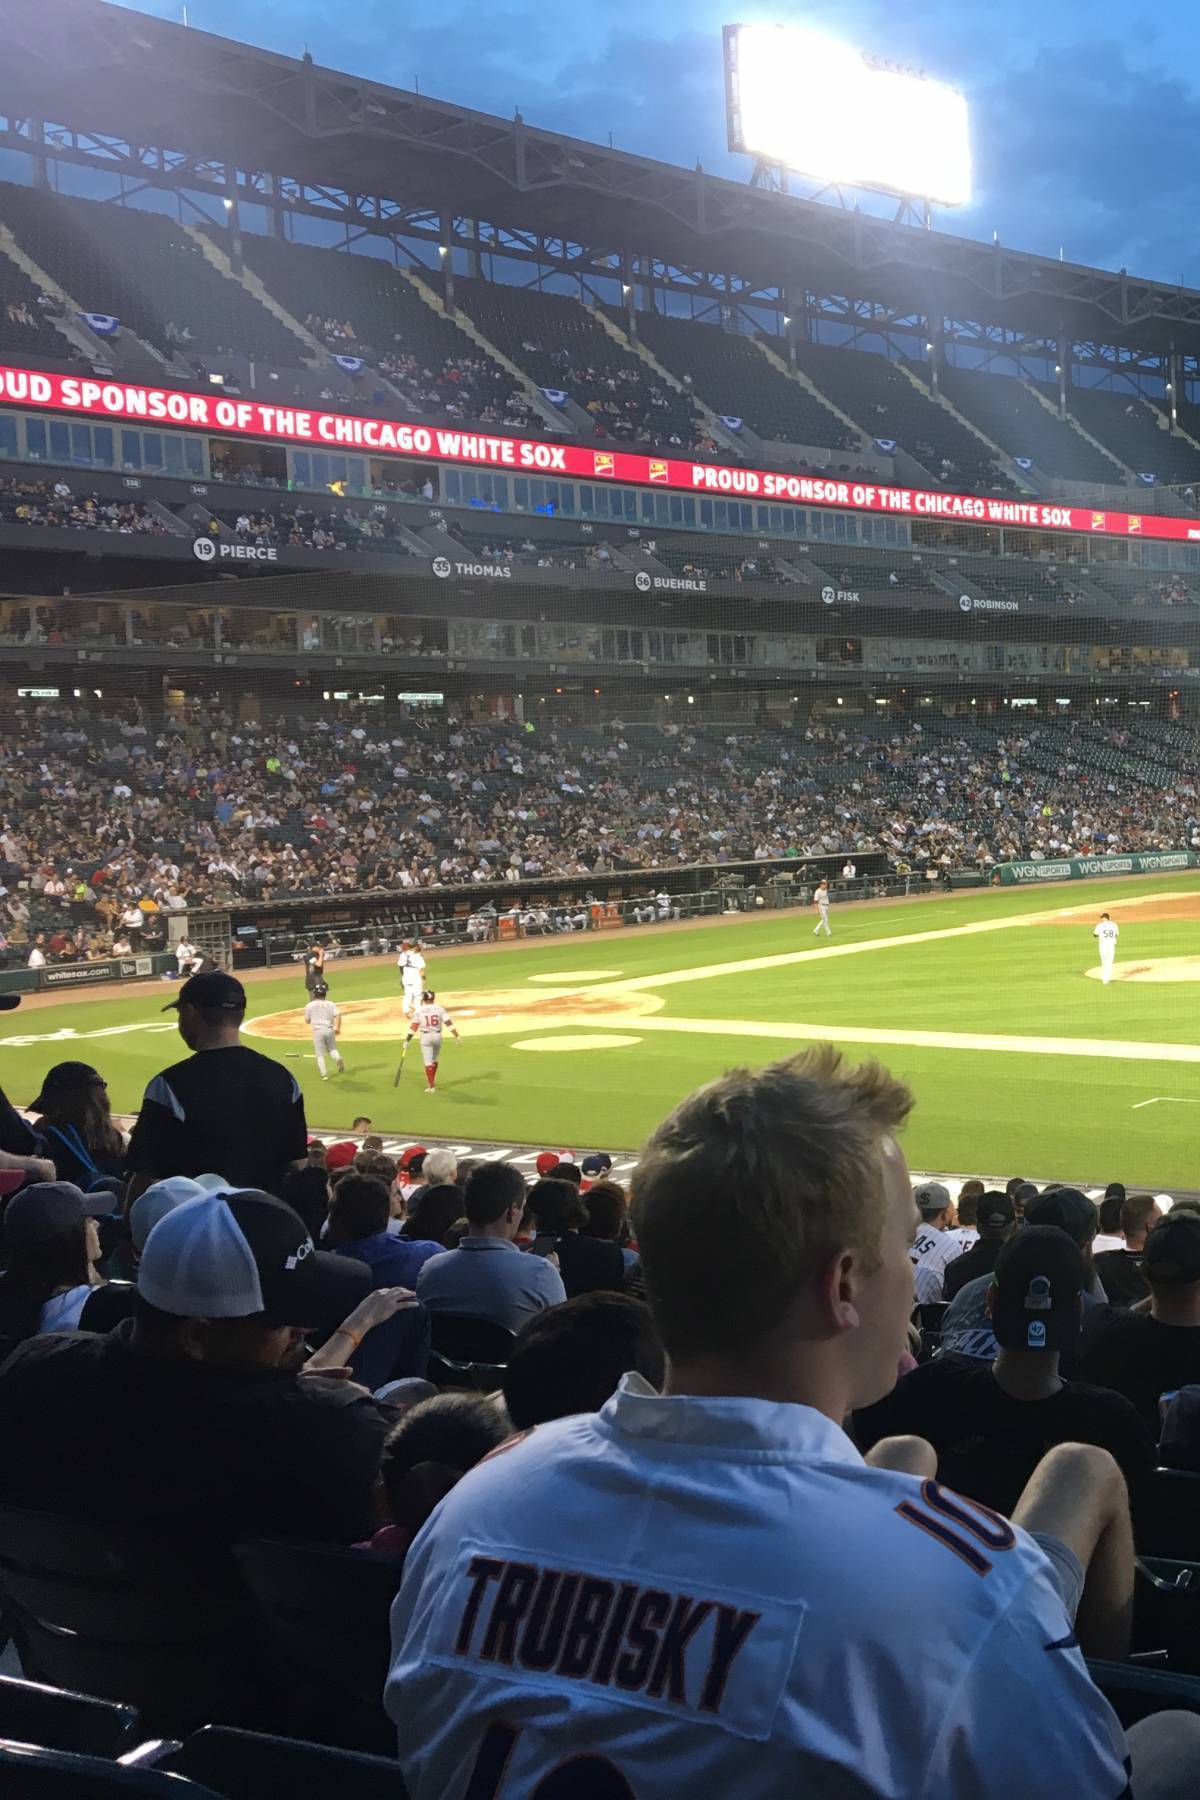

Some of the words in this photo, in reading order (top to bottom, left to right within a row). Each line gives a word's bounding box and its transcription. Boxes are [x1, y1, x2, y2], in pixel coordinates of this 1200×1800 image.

[0, 369, 51, 402] UD
[60, 378, 209, 424] SPONSOR
[215, 400, 252, 429] OF
[258, 406, 311, 437] THE
[318, 416, 432, 453] CHICAGO
[436, 431, 515, 464] WHITE
[520, 443, 567, 471] SOX
[692, 465, 760, 493] PROUD
[763, 475, 849, 504] SPONSOR
[852, 485, 875, 506] OF
[879, 488, 911, 512] THE
[915, 492, 985, 518] CHICAGO
[988, 501, 1038, 524] WHITE
[1042, 506, 1072, 527] SOX
[198, 544, 212, 557] 19
[220, 545, 278, 561] PIERCE
[434, 560, 450, 575] 35
[455, 563, 512, 579] THOMAS
[637, 575, 650, 588] 56
[654, 576, 707, 591] BUEHRLE
[838, 592, 860, 603] FISK
[974, 599, 1019, 611] ROBINSON
[1079, 861, 1105, 874] WGN
[1140, 857, 1163, 869] WGN
[1012, 865, 1040, 879] WGN
[47, 967, 110, 980] whitesox.com
[895, 1478, 1017, 1578] 10
[453, 1556, 762, 1714] TRUBISKY
